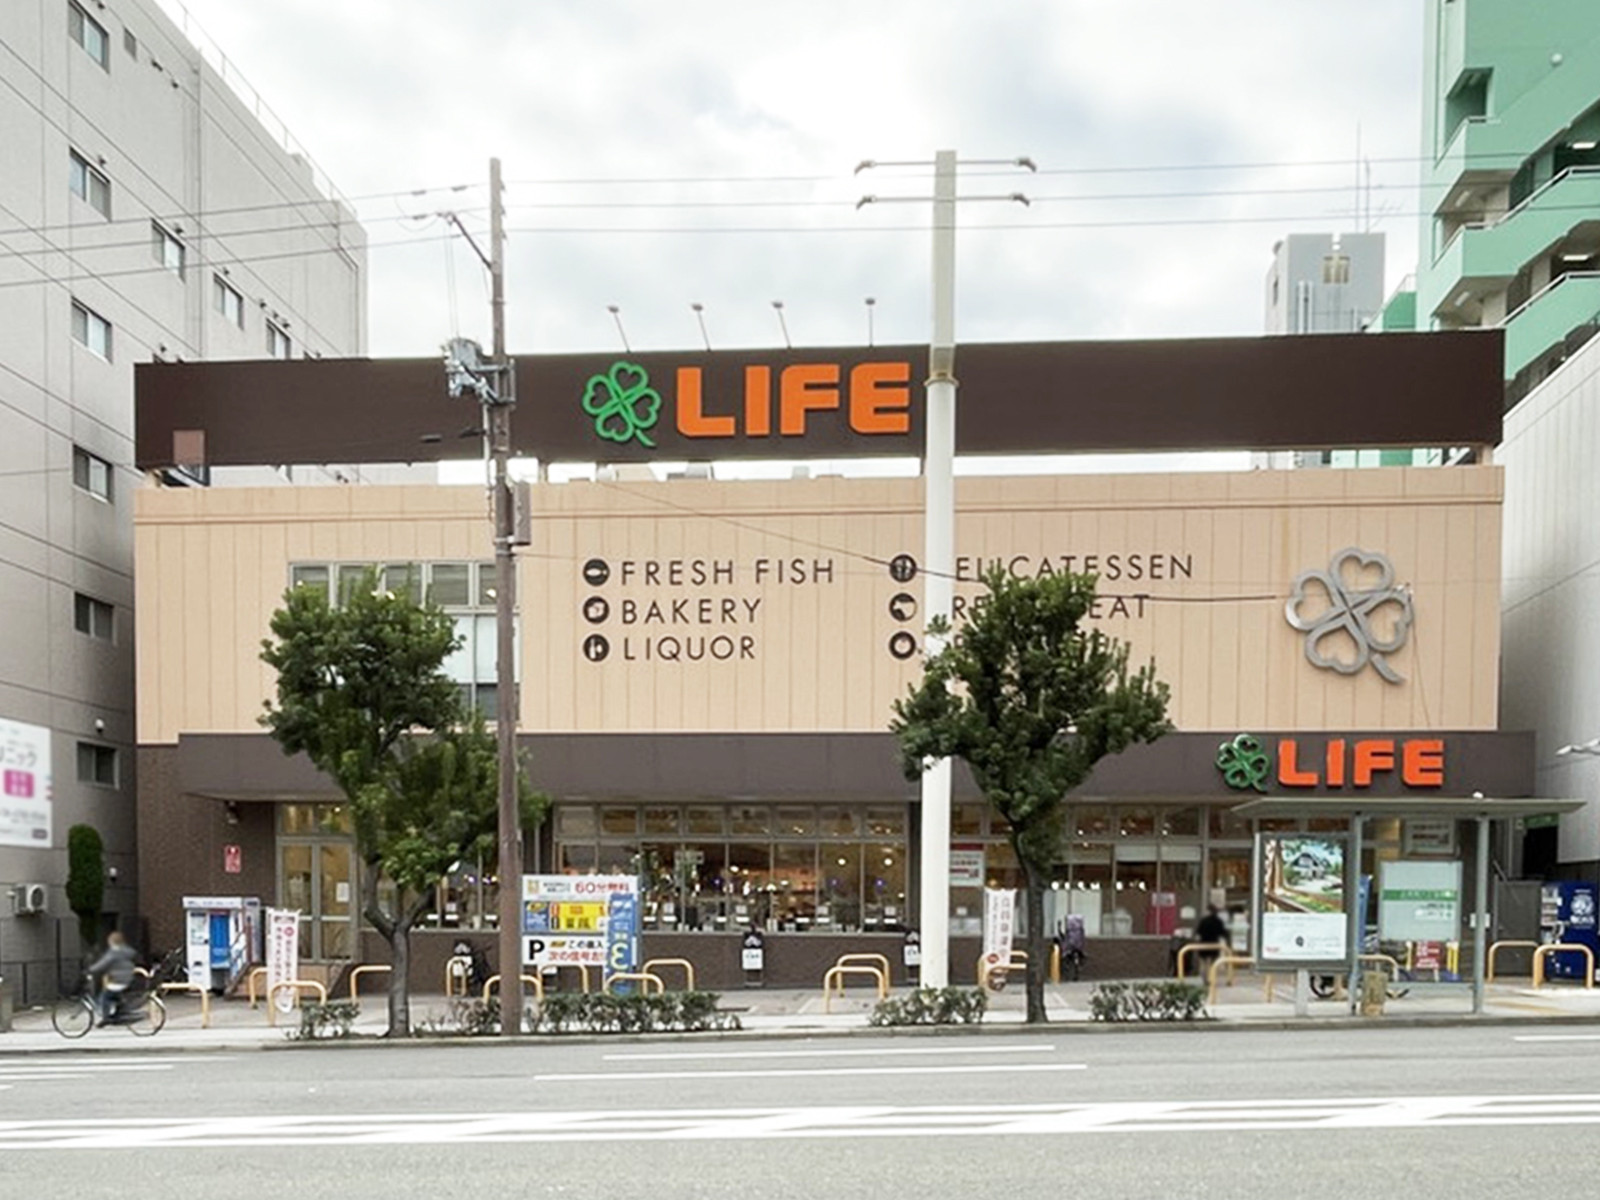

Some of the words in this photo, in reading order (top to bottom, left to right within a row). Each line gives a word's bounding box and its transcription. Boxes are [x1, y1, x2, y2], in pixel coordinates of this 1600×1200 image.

[677, 362, 910, 437] LIFE
[621, 559, 734, 586] FRESH
[755, 558, 834, 585] FISH
[621, 598, 761, 625] BAKERY
[623, 635, 756, 662] LIQUOR
[1278, 739, 1444, 786] LIFE
[528, 939, 546, 961] P
